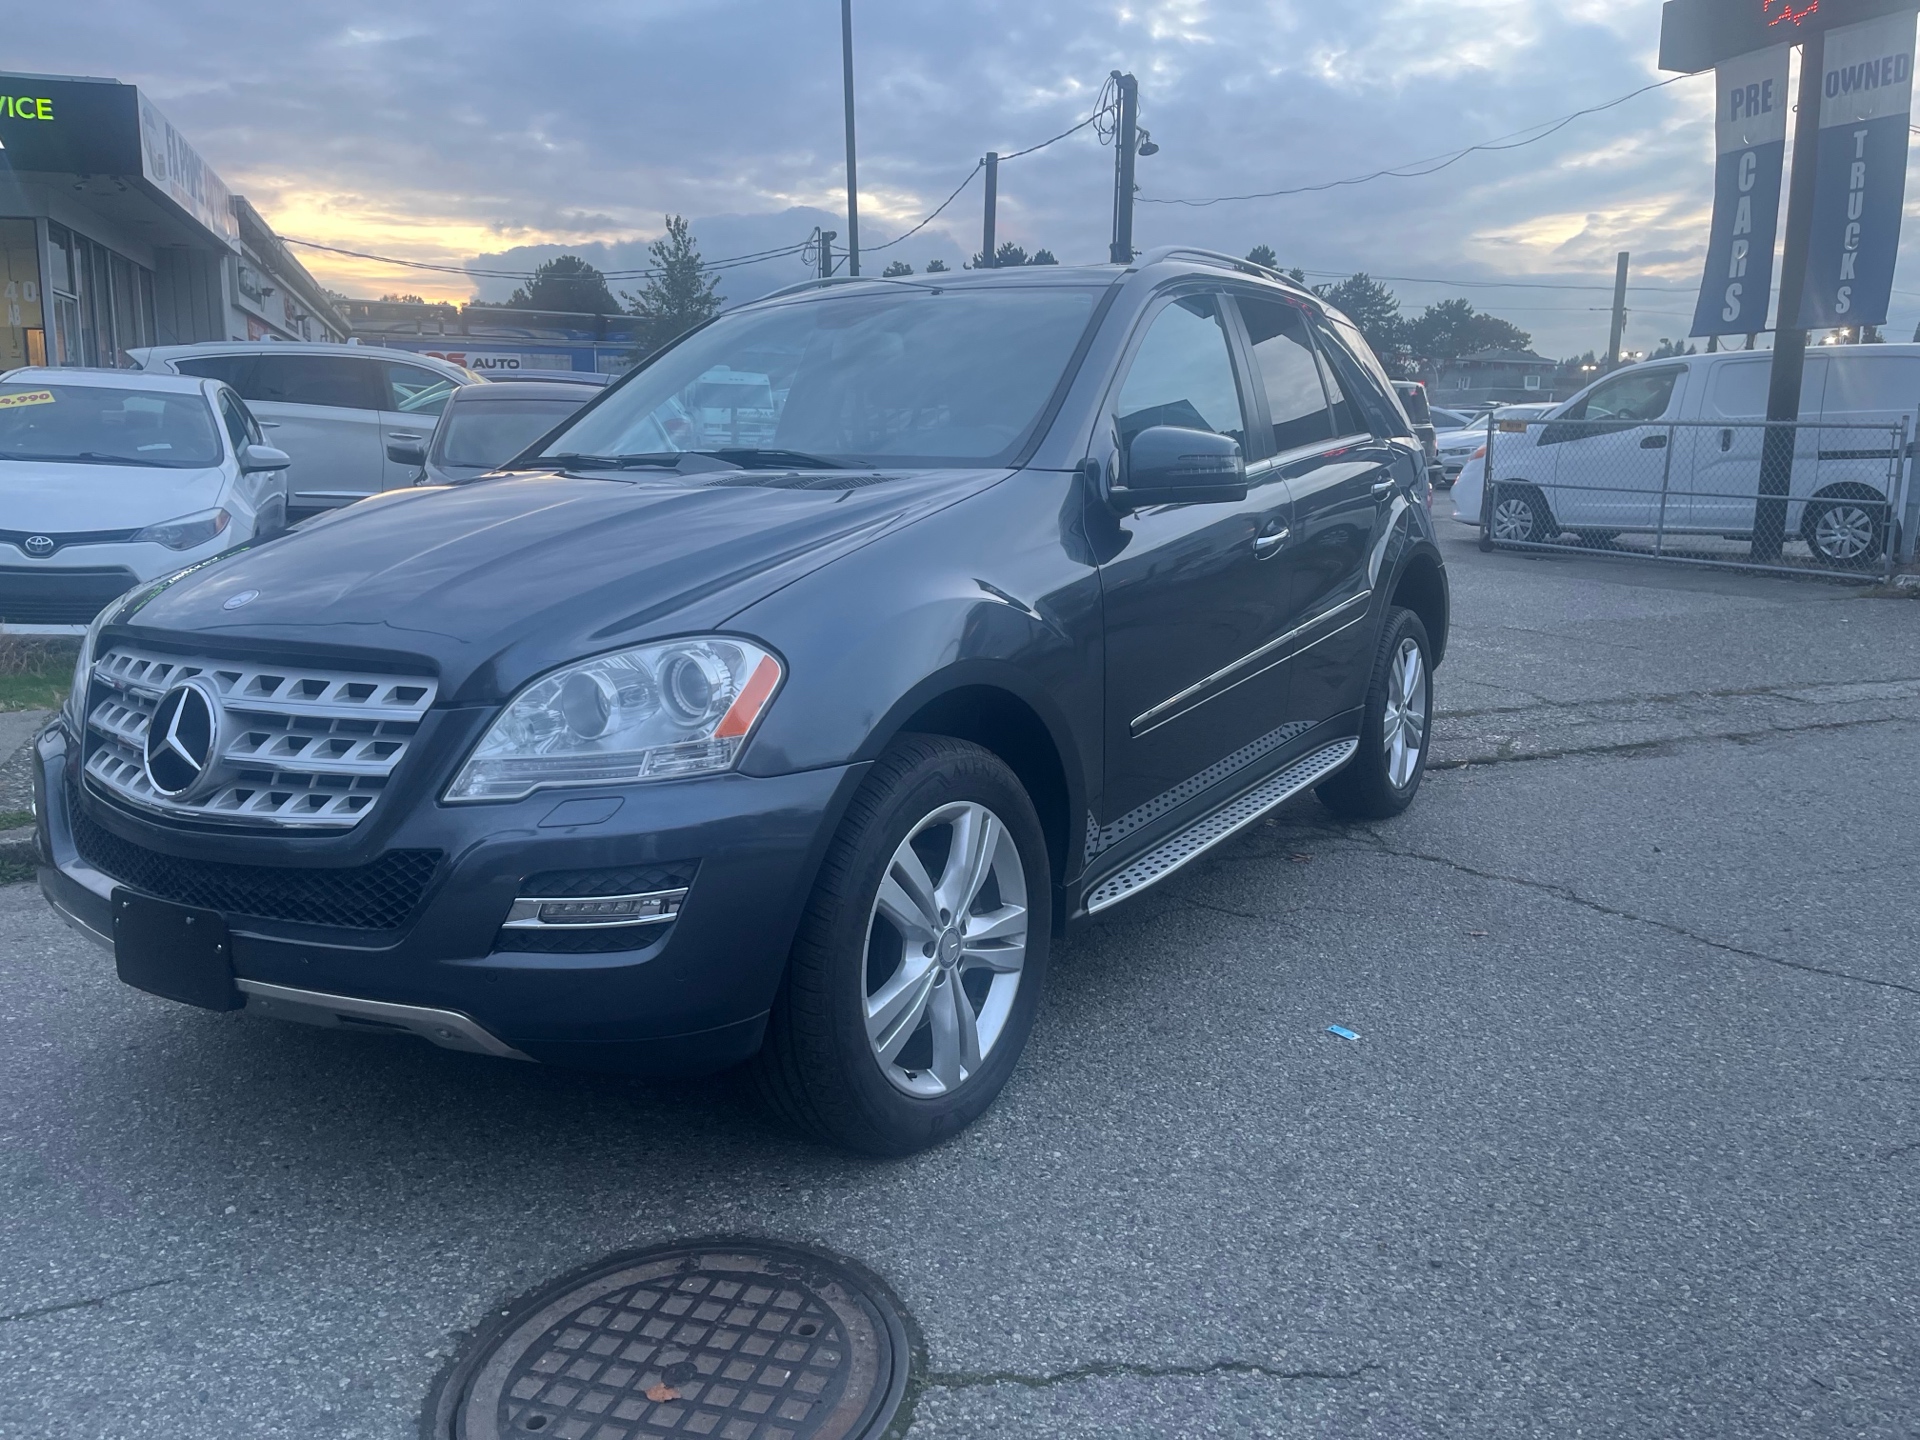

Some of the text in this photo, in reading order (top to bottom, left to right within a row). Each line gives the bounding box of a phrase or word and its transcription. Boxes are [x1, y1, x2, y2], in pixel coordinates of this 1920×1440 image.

[1825, 52, 1910, 99] OWNED
[1730, 78, 1774, 123] PRE
[1722, 151, 1757, 322] CARS
[1835, 129, 1868, 314] TRUCKS
[472, 357, 520, 370] AUTO
